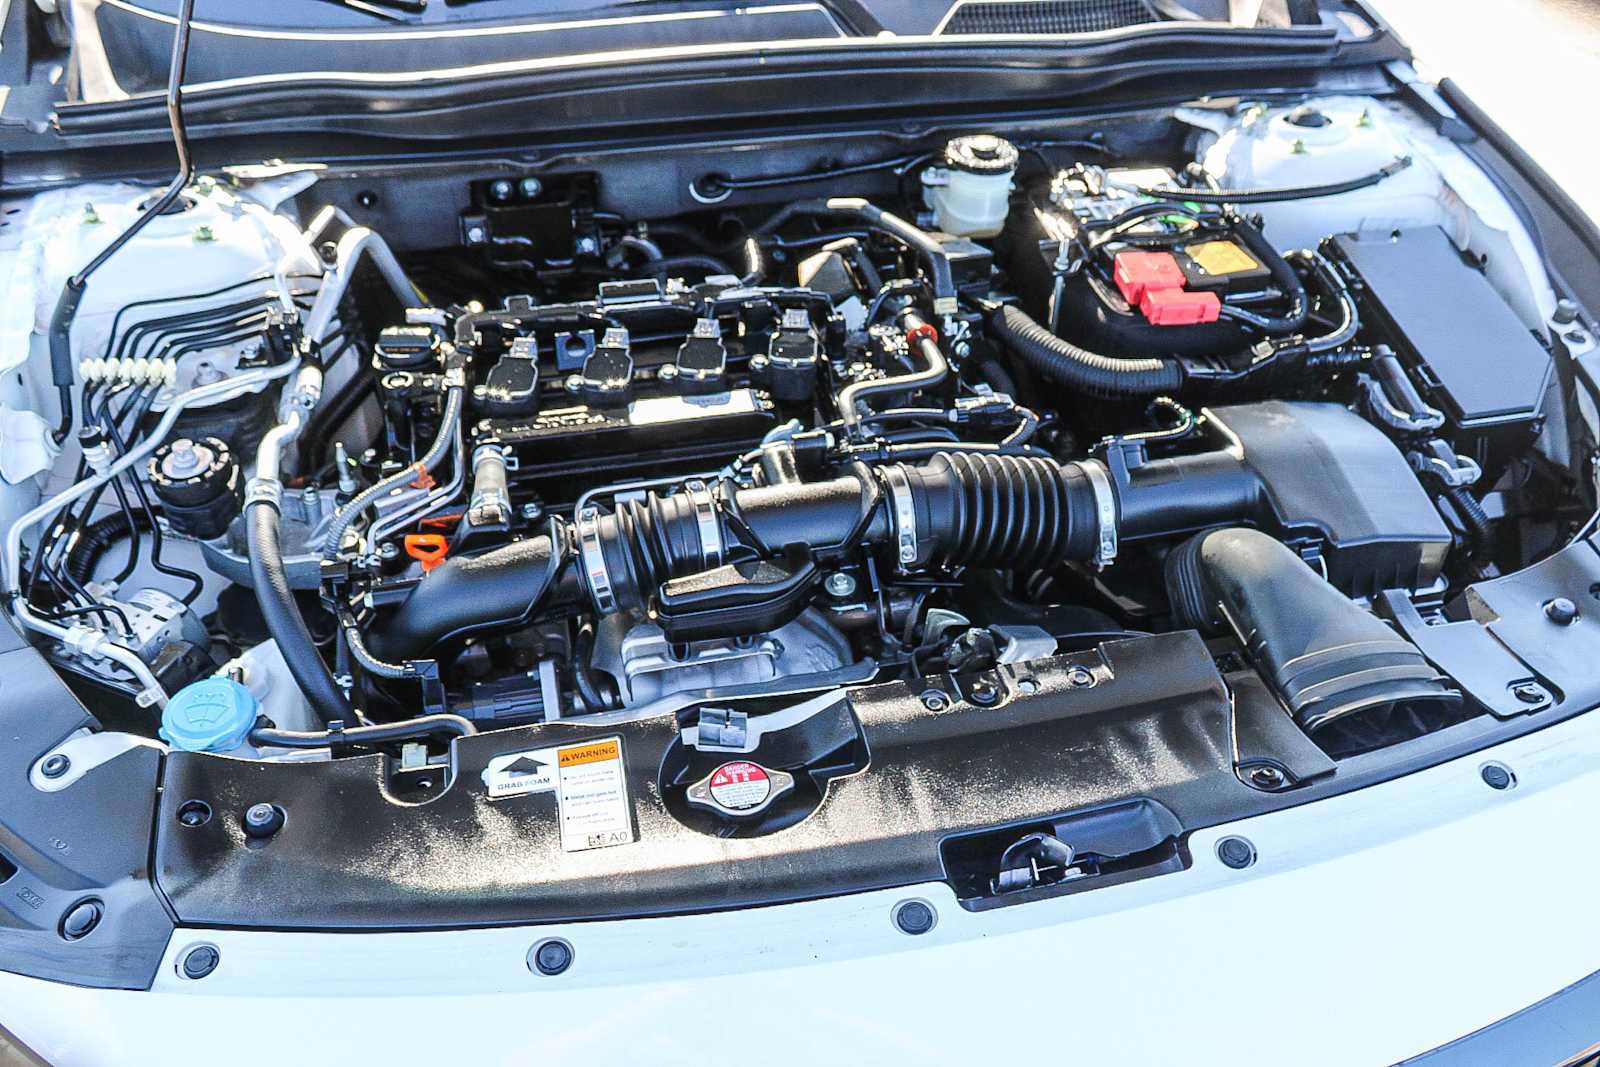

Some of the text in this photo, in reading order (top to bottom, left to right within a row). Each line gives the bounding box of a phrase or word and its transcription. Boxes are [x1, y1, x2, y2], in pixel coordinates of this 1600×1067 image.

[571, 746, 616, 760] WARNING
[497, 777, 550, 790] GRAB FOAM
